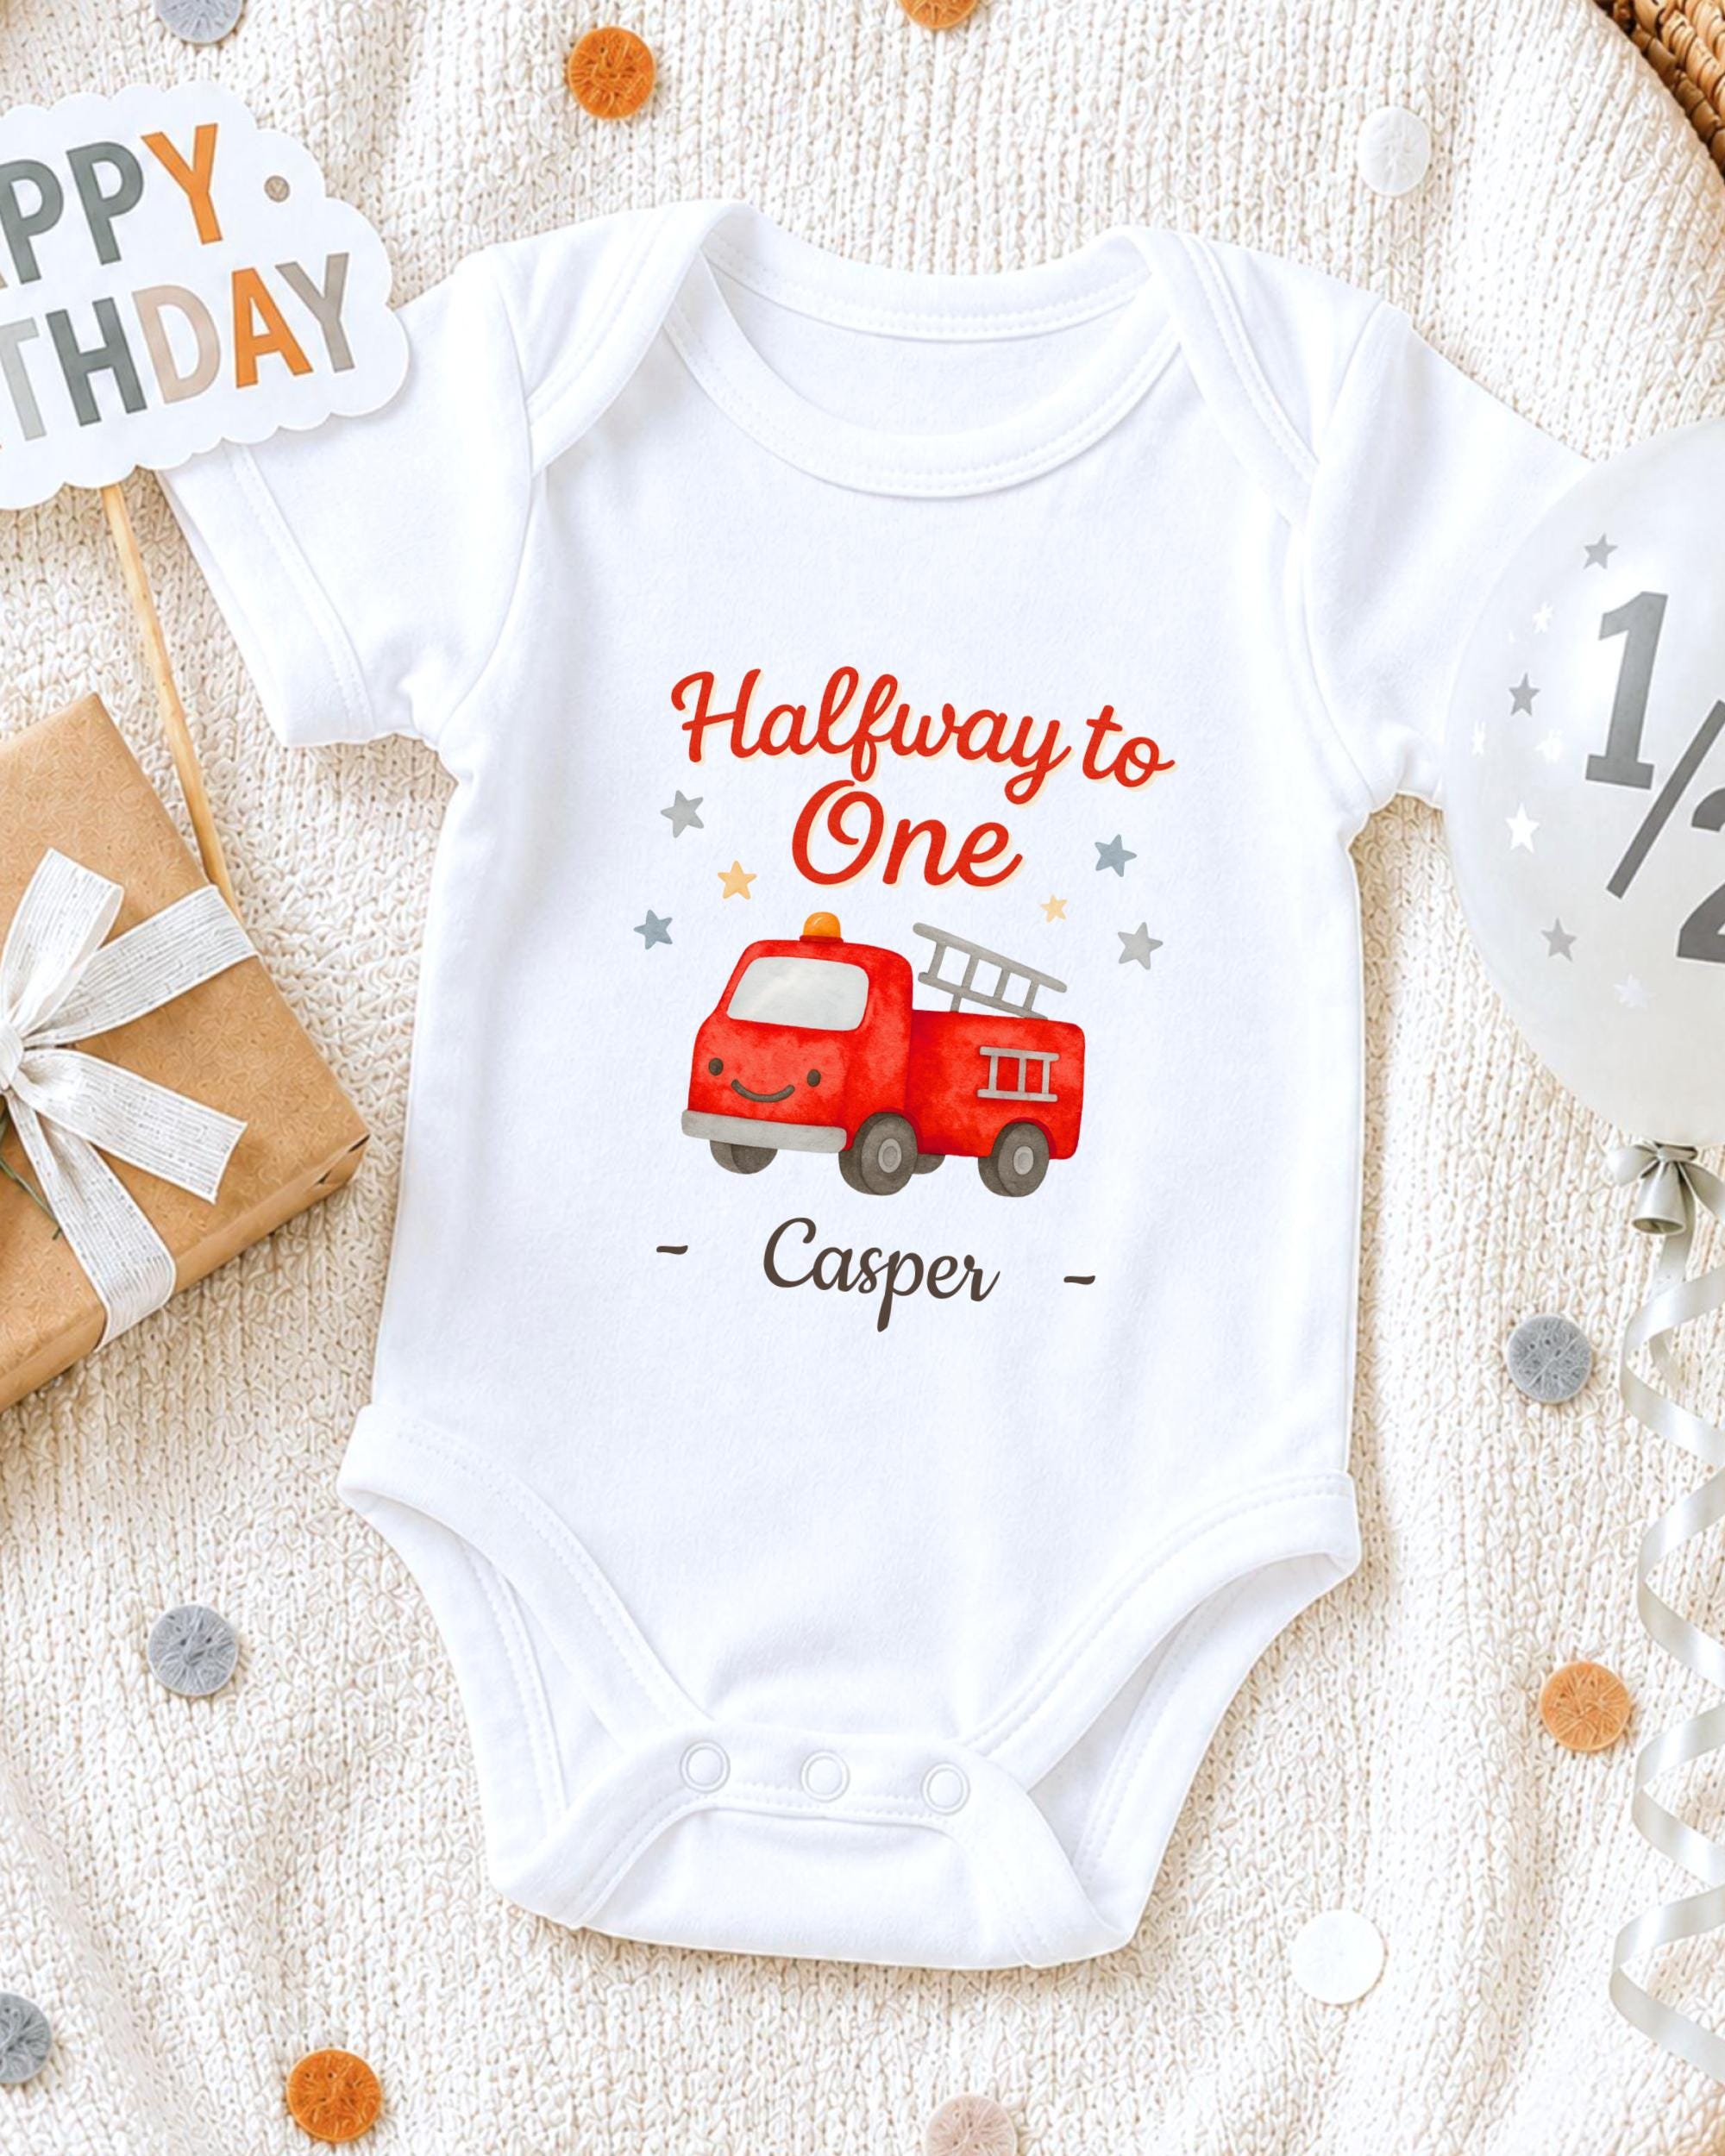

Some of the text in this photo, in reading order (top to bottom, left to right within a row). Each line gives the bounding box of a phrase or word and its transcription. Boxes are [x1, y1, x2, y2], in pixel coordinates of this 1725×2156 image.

[0, 122, 223, 290] PPY
[0, 252, 355, 442] THDAY
[671, 666, 1176, 805] Halfway to
[792, 780, 1024, 887] One
[763, 1217, 1000, 1332] Casper
